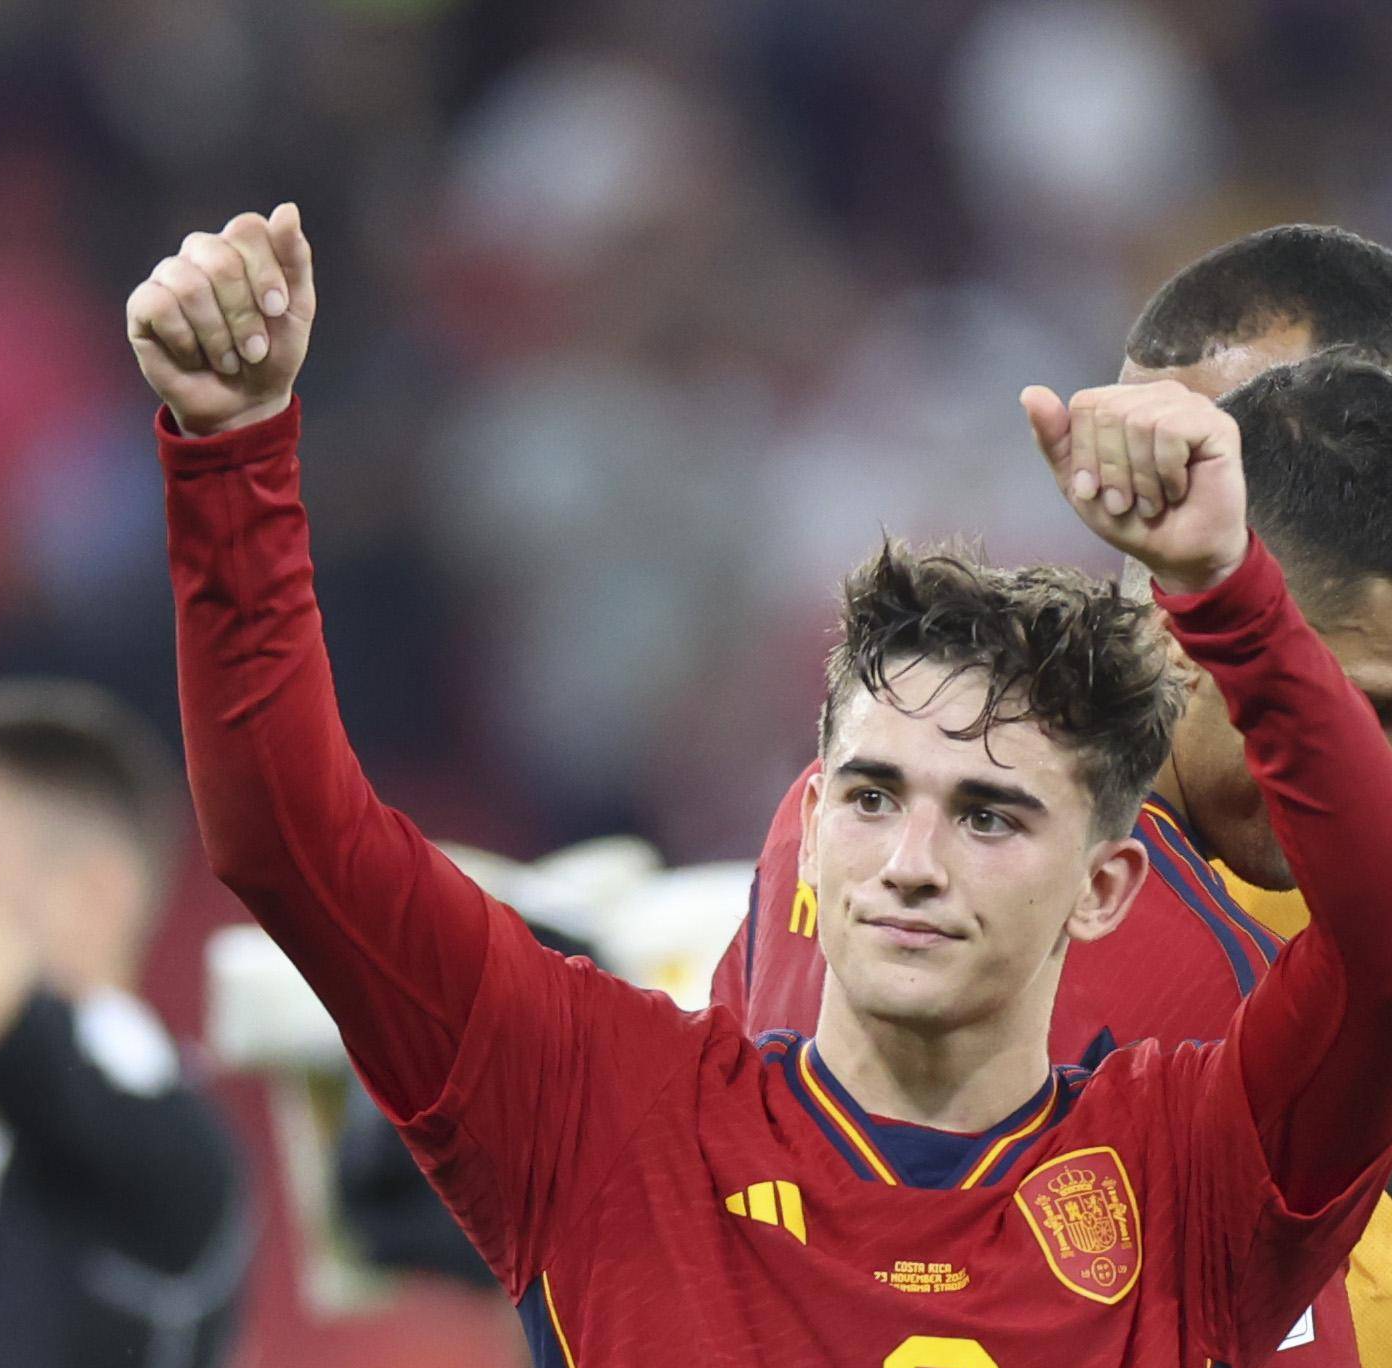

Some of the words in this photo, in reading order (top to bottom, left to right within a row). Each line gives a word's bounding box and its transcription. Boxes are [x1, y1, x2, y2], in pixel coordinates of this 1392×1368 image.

[894, 1261, 925, 1273] COSTA
[928, 1263, 952, 1273] RICA
[891, 1272, 943, 1284] NOVEMBER
